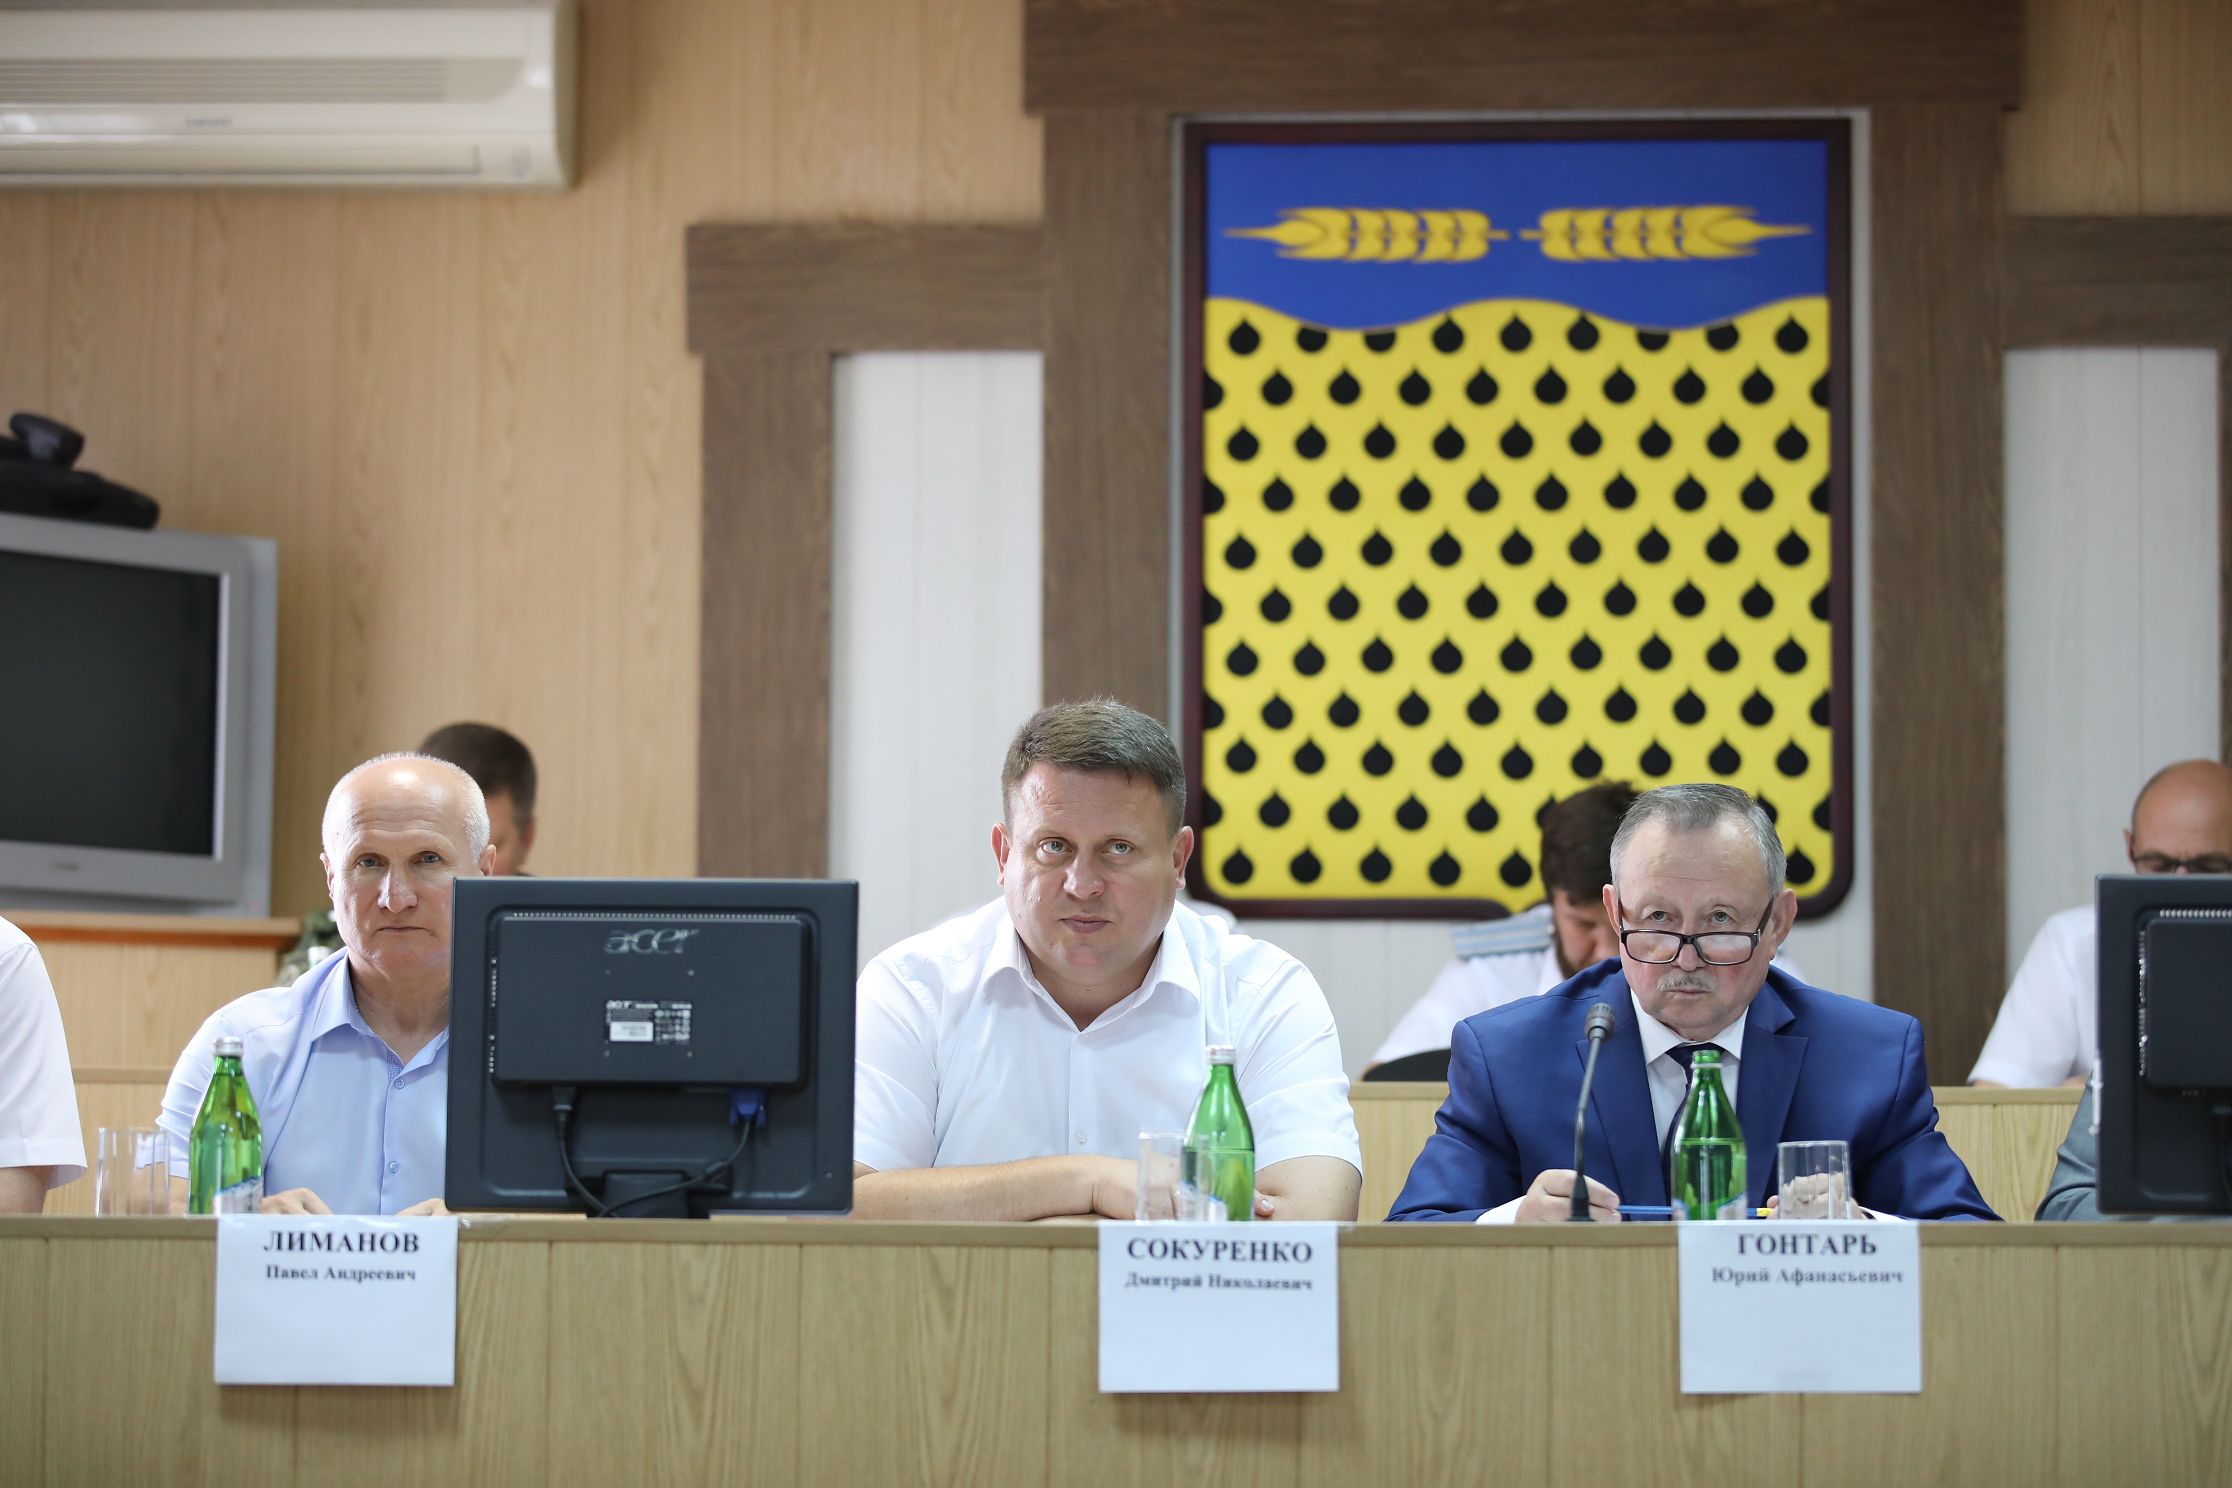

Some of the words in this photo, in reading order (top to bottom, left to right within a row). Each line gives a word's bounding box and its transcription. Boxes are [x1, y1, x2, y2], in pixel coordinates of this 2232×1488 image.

[604, 928, 699, 954] acer
[263, 1230, 420, 1253] ЛИМАНОВ
[1127, 1237, 1313, 1264] СОКУРЕНКО
[1737, 1233, 1878, 1256] ГОНТАРЬ
[266, 1264, 318, 1280] Павел
[324, 1265, 417, 1283] Андреевич
[1125, 1271, 1203, 1290] Дмитрий
[1208, 1274, 1313, 1291] Николаевич
[1712, 1266, 1769, 1287] Юрий
[1776, 1266, 1904, 1288] Афанасьевич
